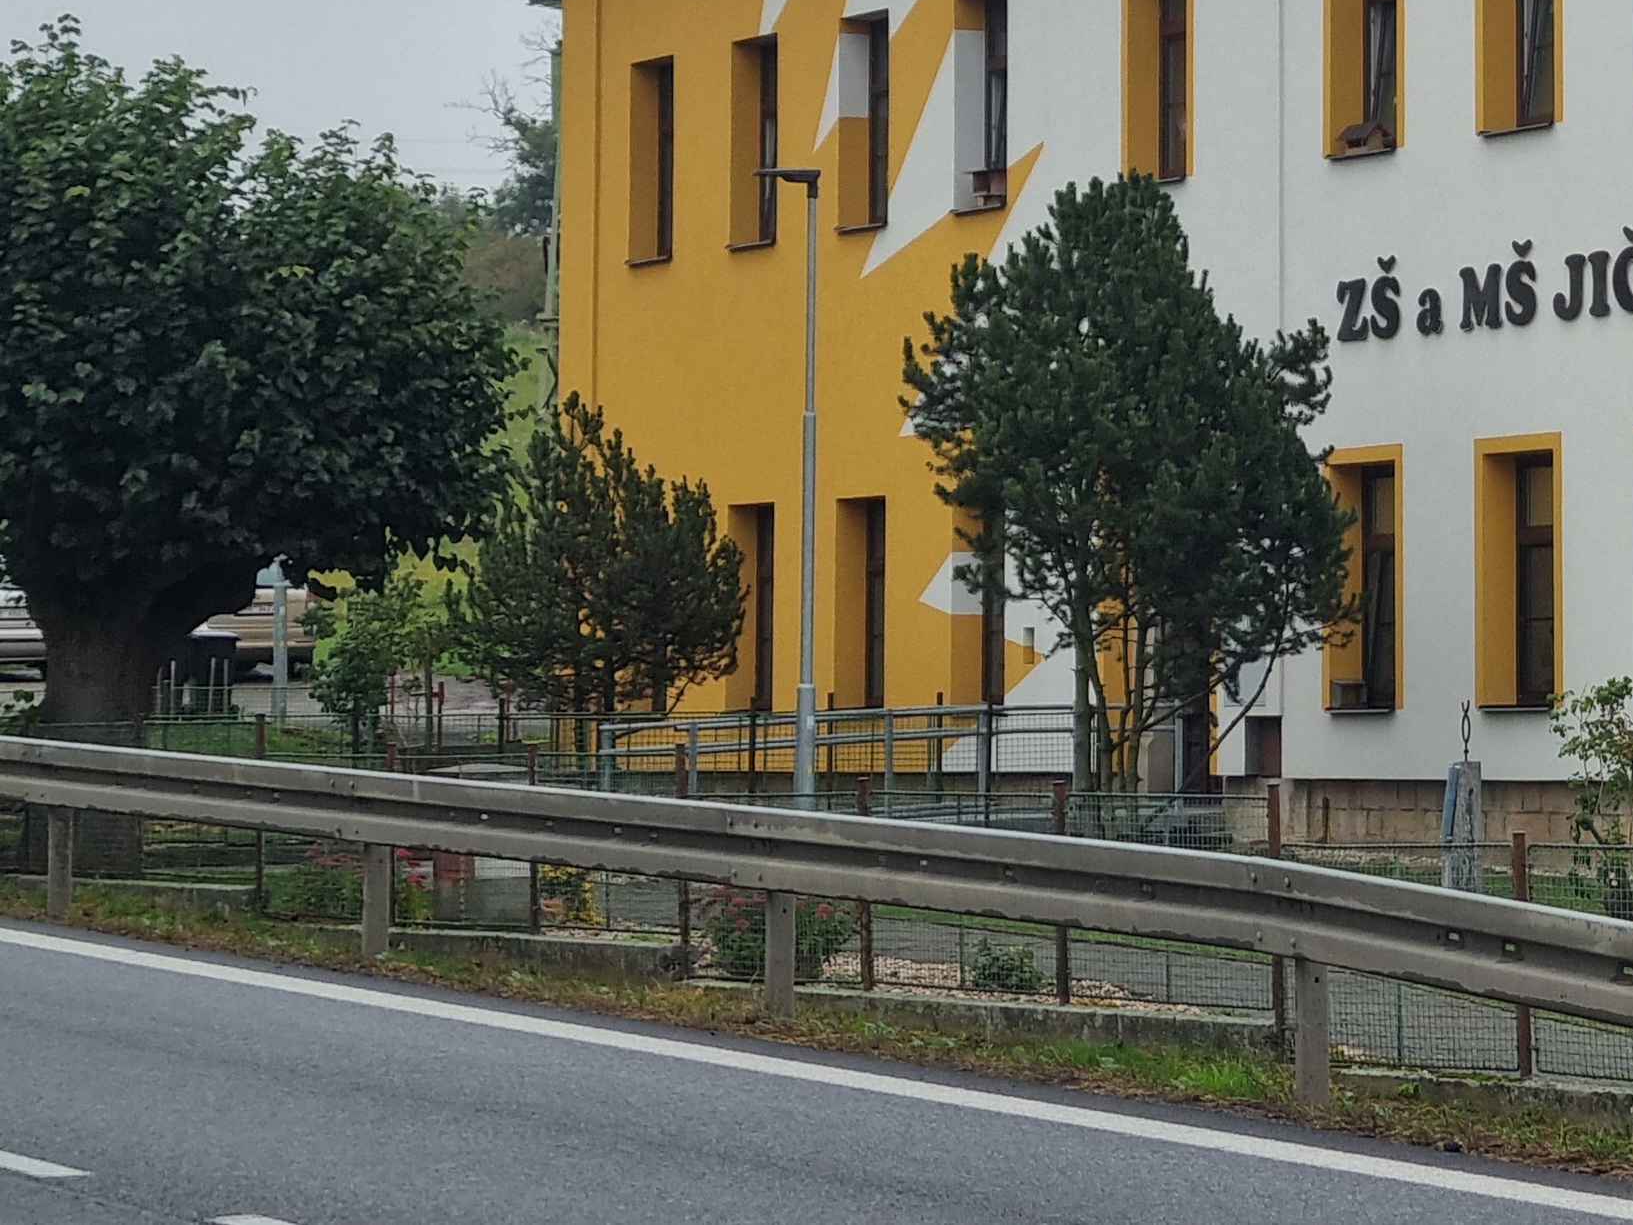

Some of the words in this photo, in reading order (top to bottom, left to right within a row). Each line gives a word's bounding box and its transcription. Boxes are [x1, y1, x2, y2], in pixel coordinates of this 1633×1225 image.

[1336, 254, 1401, 343] ZŠ
[1416, 287, 1444, 337] a
[1459, 239, 1538, 334] MŠ
